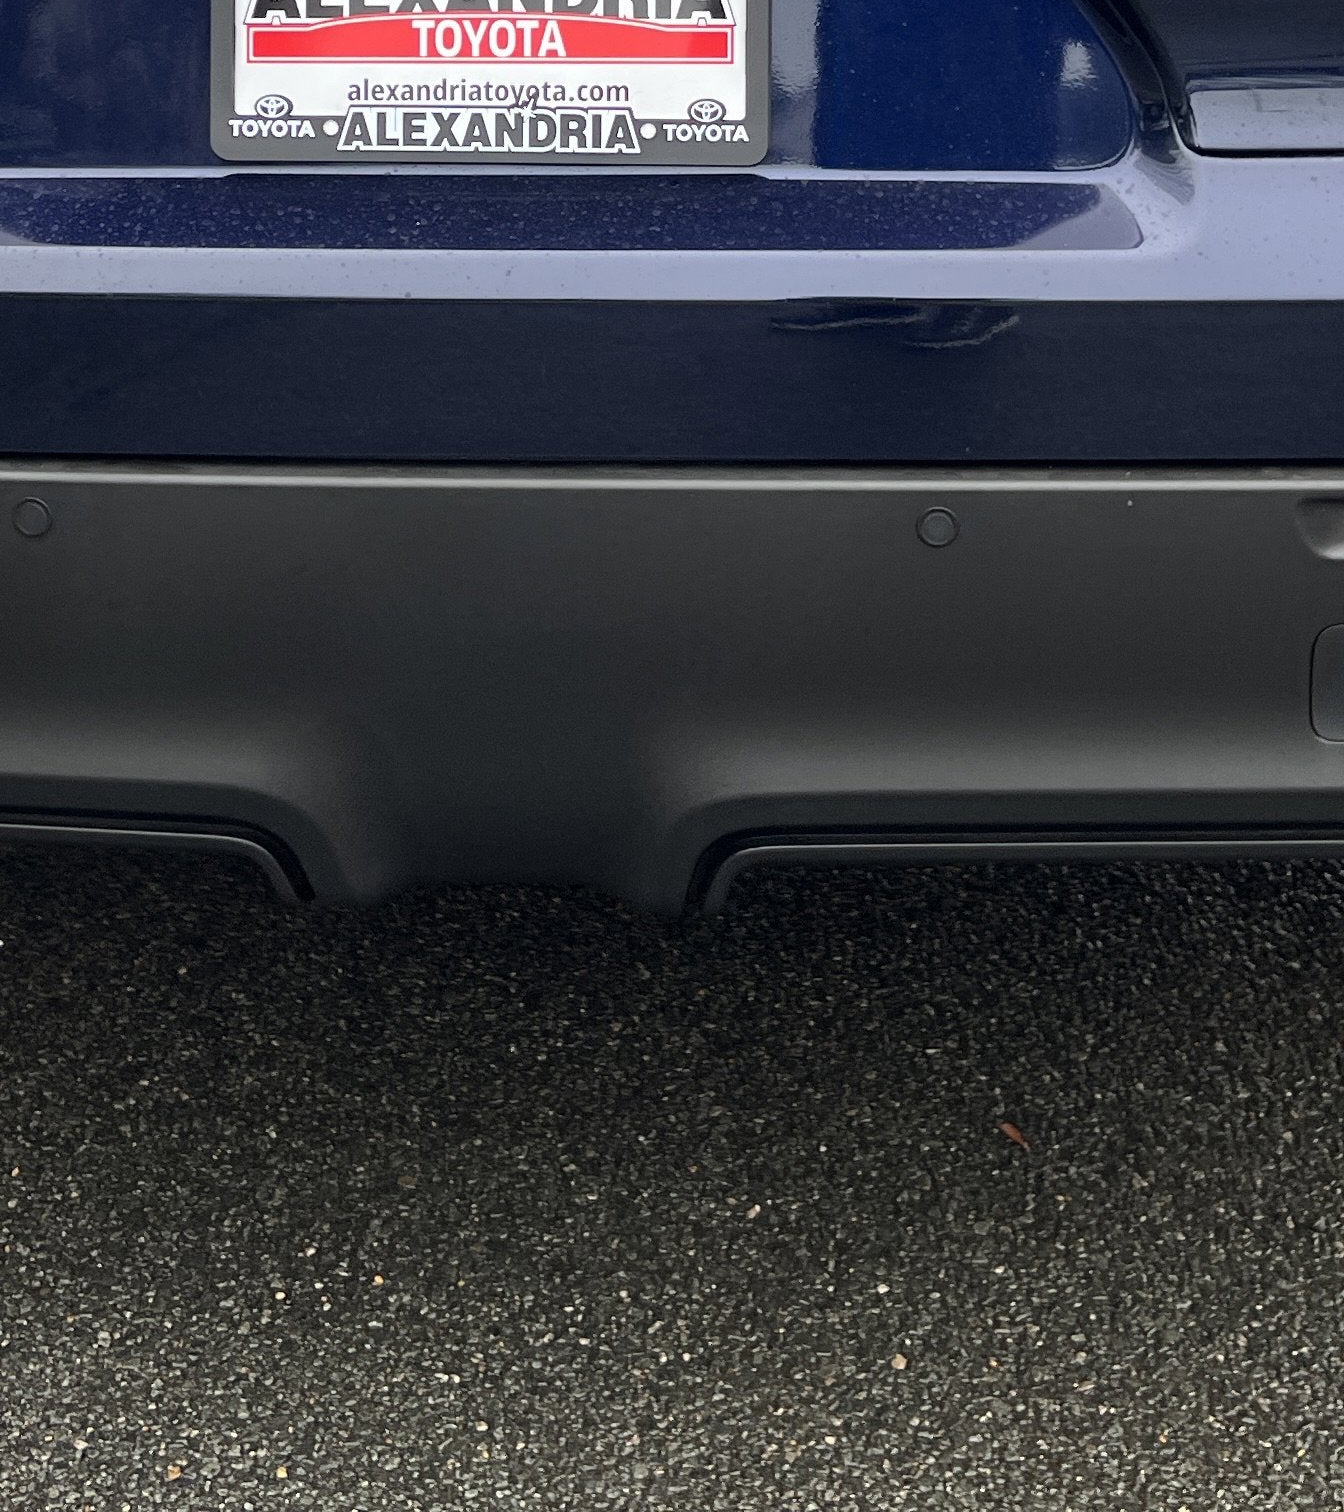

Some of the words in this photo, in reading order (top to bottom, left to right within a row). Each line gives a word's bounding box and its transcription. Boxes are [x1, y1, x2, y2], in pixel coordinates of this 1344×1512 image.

[411, 19, 567, 58] TOYOTA
[347, 77, 630, 105] alexandriatoyota.com
[228, 119, 316, 139] TOYOTA
[342, 111, 637, 150] ALEXANDRIA
[662, 121, 749, 143] TOYOTA
